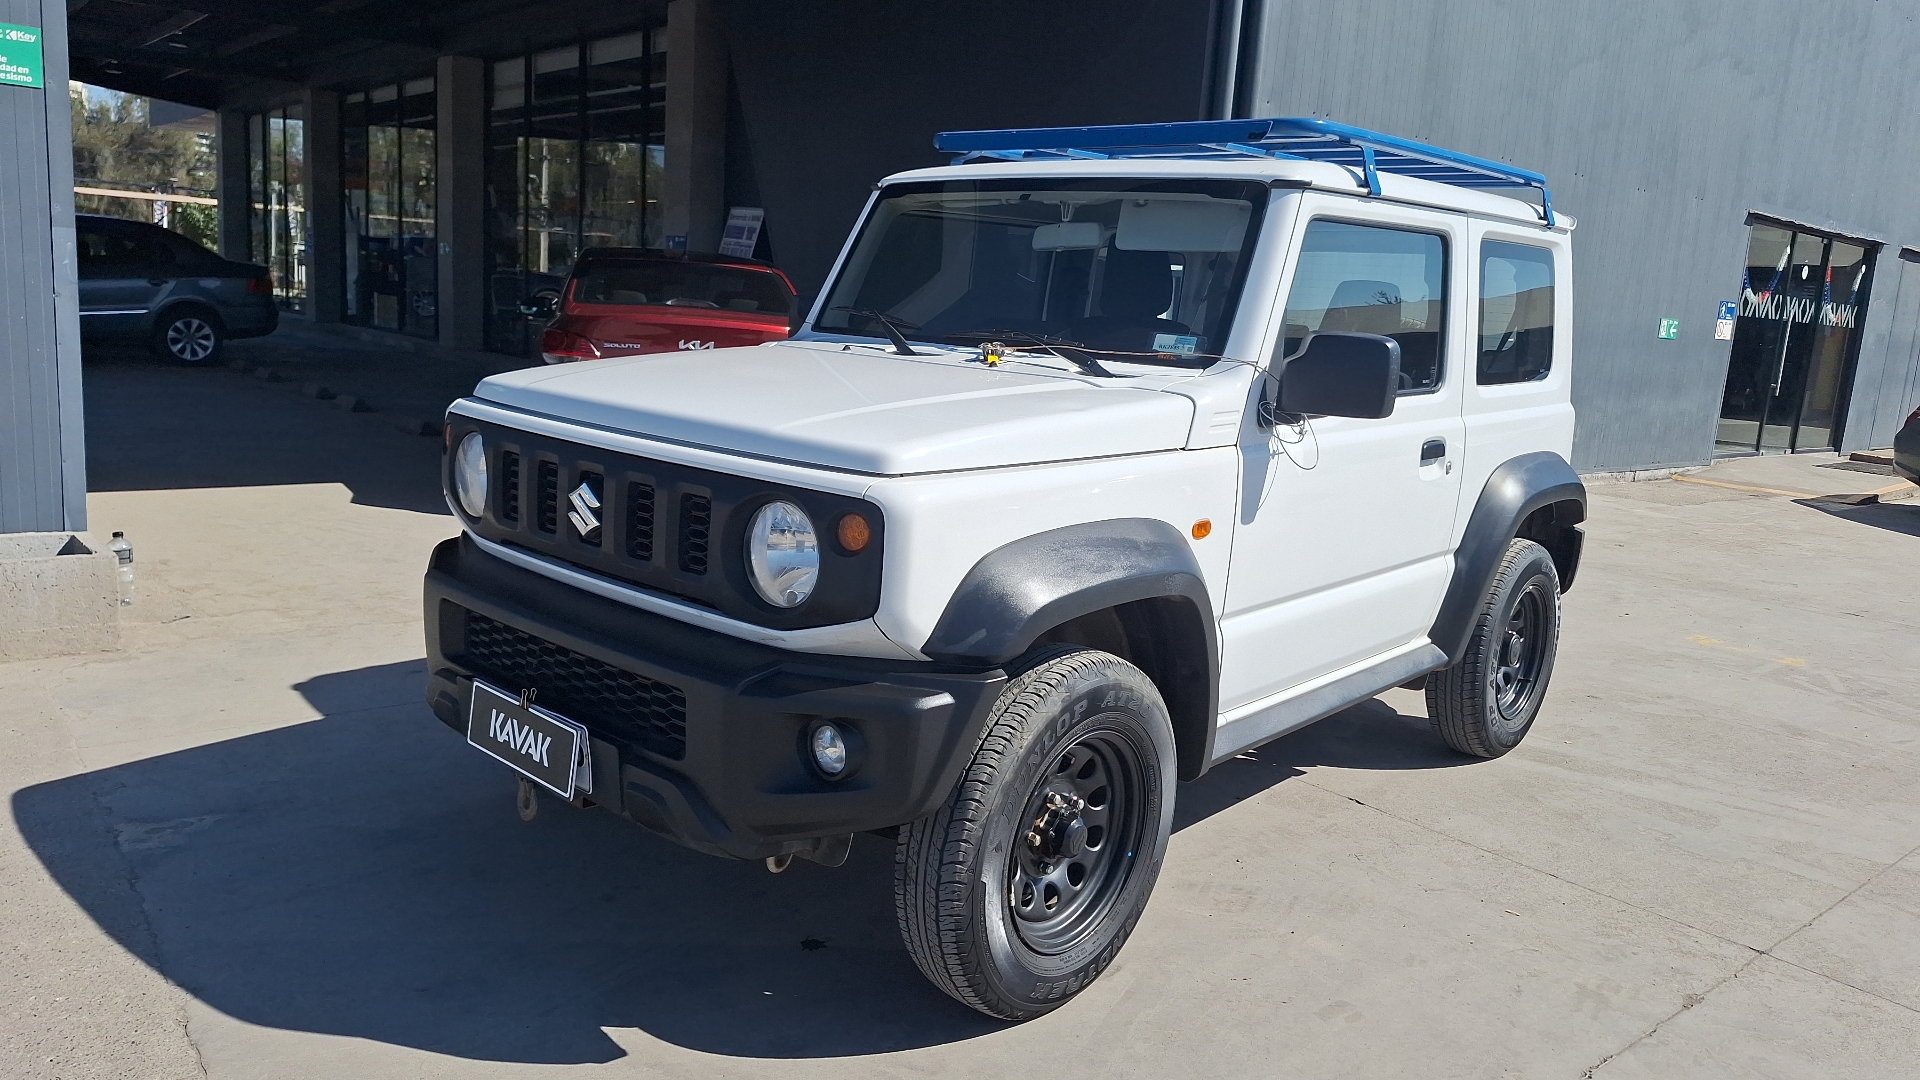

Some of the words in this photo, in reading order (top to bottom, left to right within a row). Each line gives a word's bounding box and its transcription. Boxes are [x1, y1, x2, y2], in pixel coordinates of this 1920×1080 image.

[17, 31, 36, 42] Key
[6, 72, 32, 82] sismo
[679, 339, 715, 350] KIA
[489, 708, 552, 768] KAVAK
[1000, 698, 1088, 826] DUNLOP
